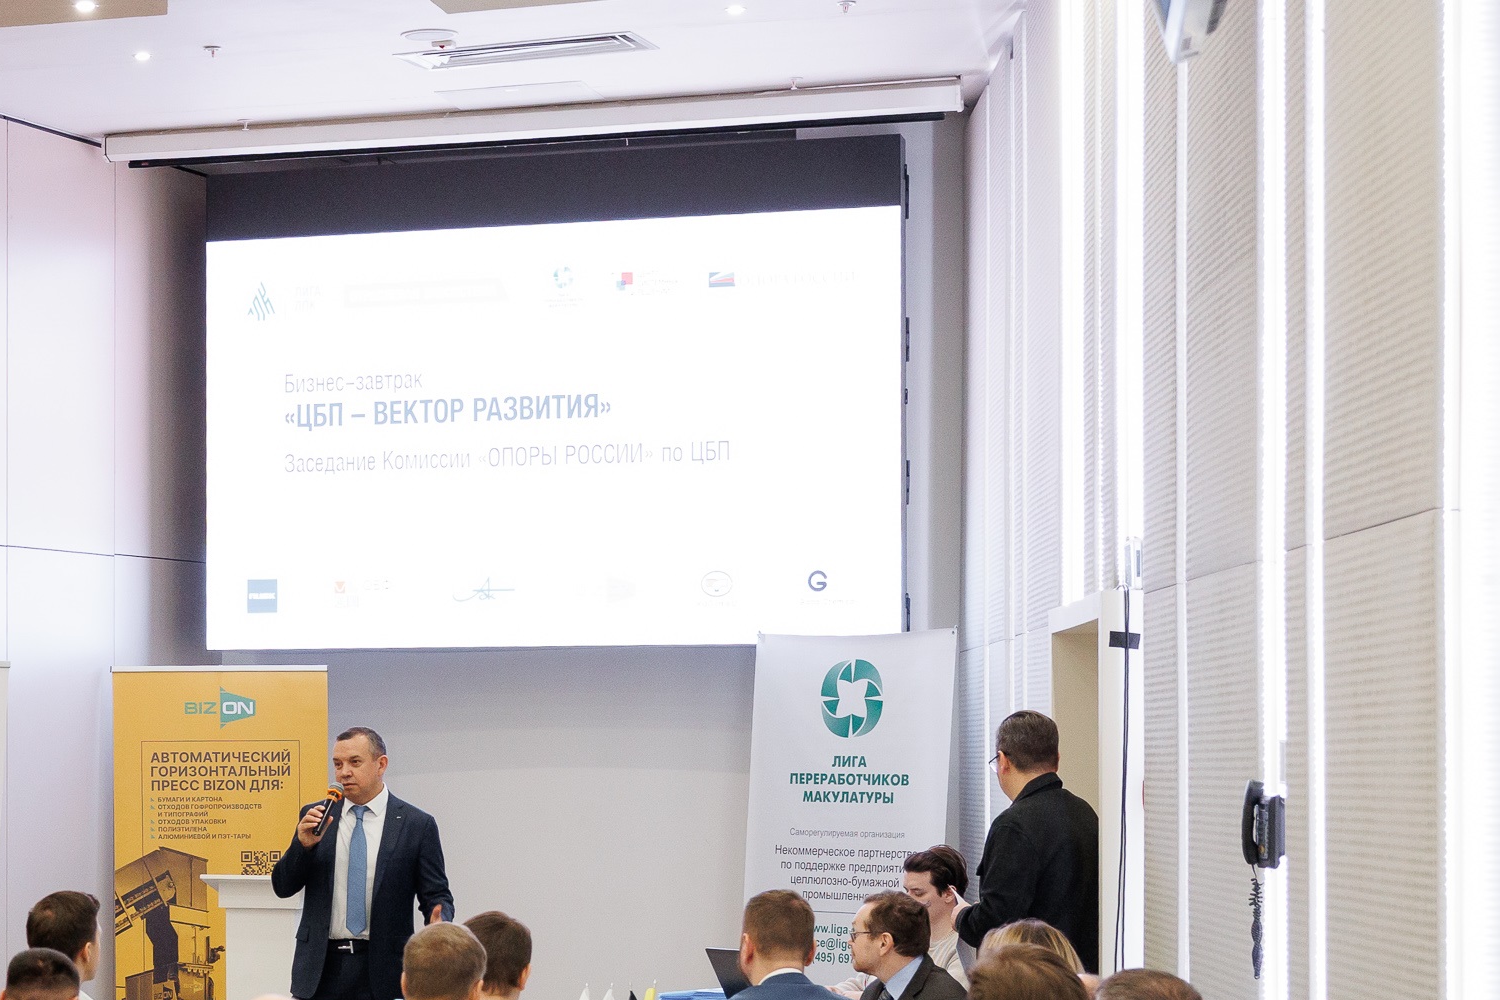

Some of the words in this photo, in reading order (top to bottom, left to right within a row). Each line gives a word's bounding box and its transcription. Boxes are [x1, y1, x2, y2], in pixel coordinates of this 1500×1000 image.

[285, 402, 343, 432] «ЦБП
[374, 398, 464, 425] ВЕКТОР
[473, 393, 611, 422] РАЗВИТИЯ»
[285, 453, 376, 475] Заседание
[383, 450, 470, 470] Комиссии
[479, 445, 557, 467] «ОПОРЫ
[565, 443, 653, 465] РОССИИ»
[662, 446, 683, 462] по
[691, 440, 730, 464] ЦБП
[150, 749, 291, 763] АВТОМАТИЧЕСКИЙ
[831, 755, 867, 768] ЛИГА
[150, 763, 291, 777] ГОРИЗОНТАЛЬНЫЙ
[151, 780, 200, 791] ПРЕСС
[203, 780, 246, 791] BIZON
[249, 780, 284, 793] ДЛЯ:
[789, 772, 910, 787] ПЕРЕРАБОТЧИКОВ
[802, 790, 894, 804] МАКУЛАТУРЫ
[164, 810, 209, 818] ТИПОГРАФИЙ
[190, 803, 262, 811] ГОФРОПРОИЗВОДСТВ
[789, 827, 859, 838] Саморегулируемая
[859, 830, 906, 839] организация
[774, 844, 855, 860] Некоммерческое
[780, 860, 792, 869] по
[794, 861, 846, 872] поддержке
[848, 863, 904, 874] предприяти
[790, 875, 900, 889] целлюлозно-бумажной
